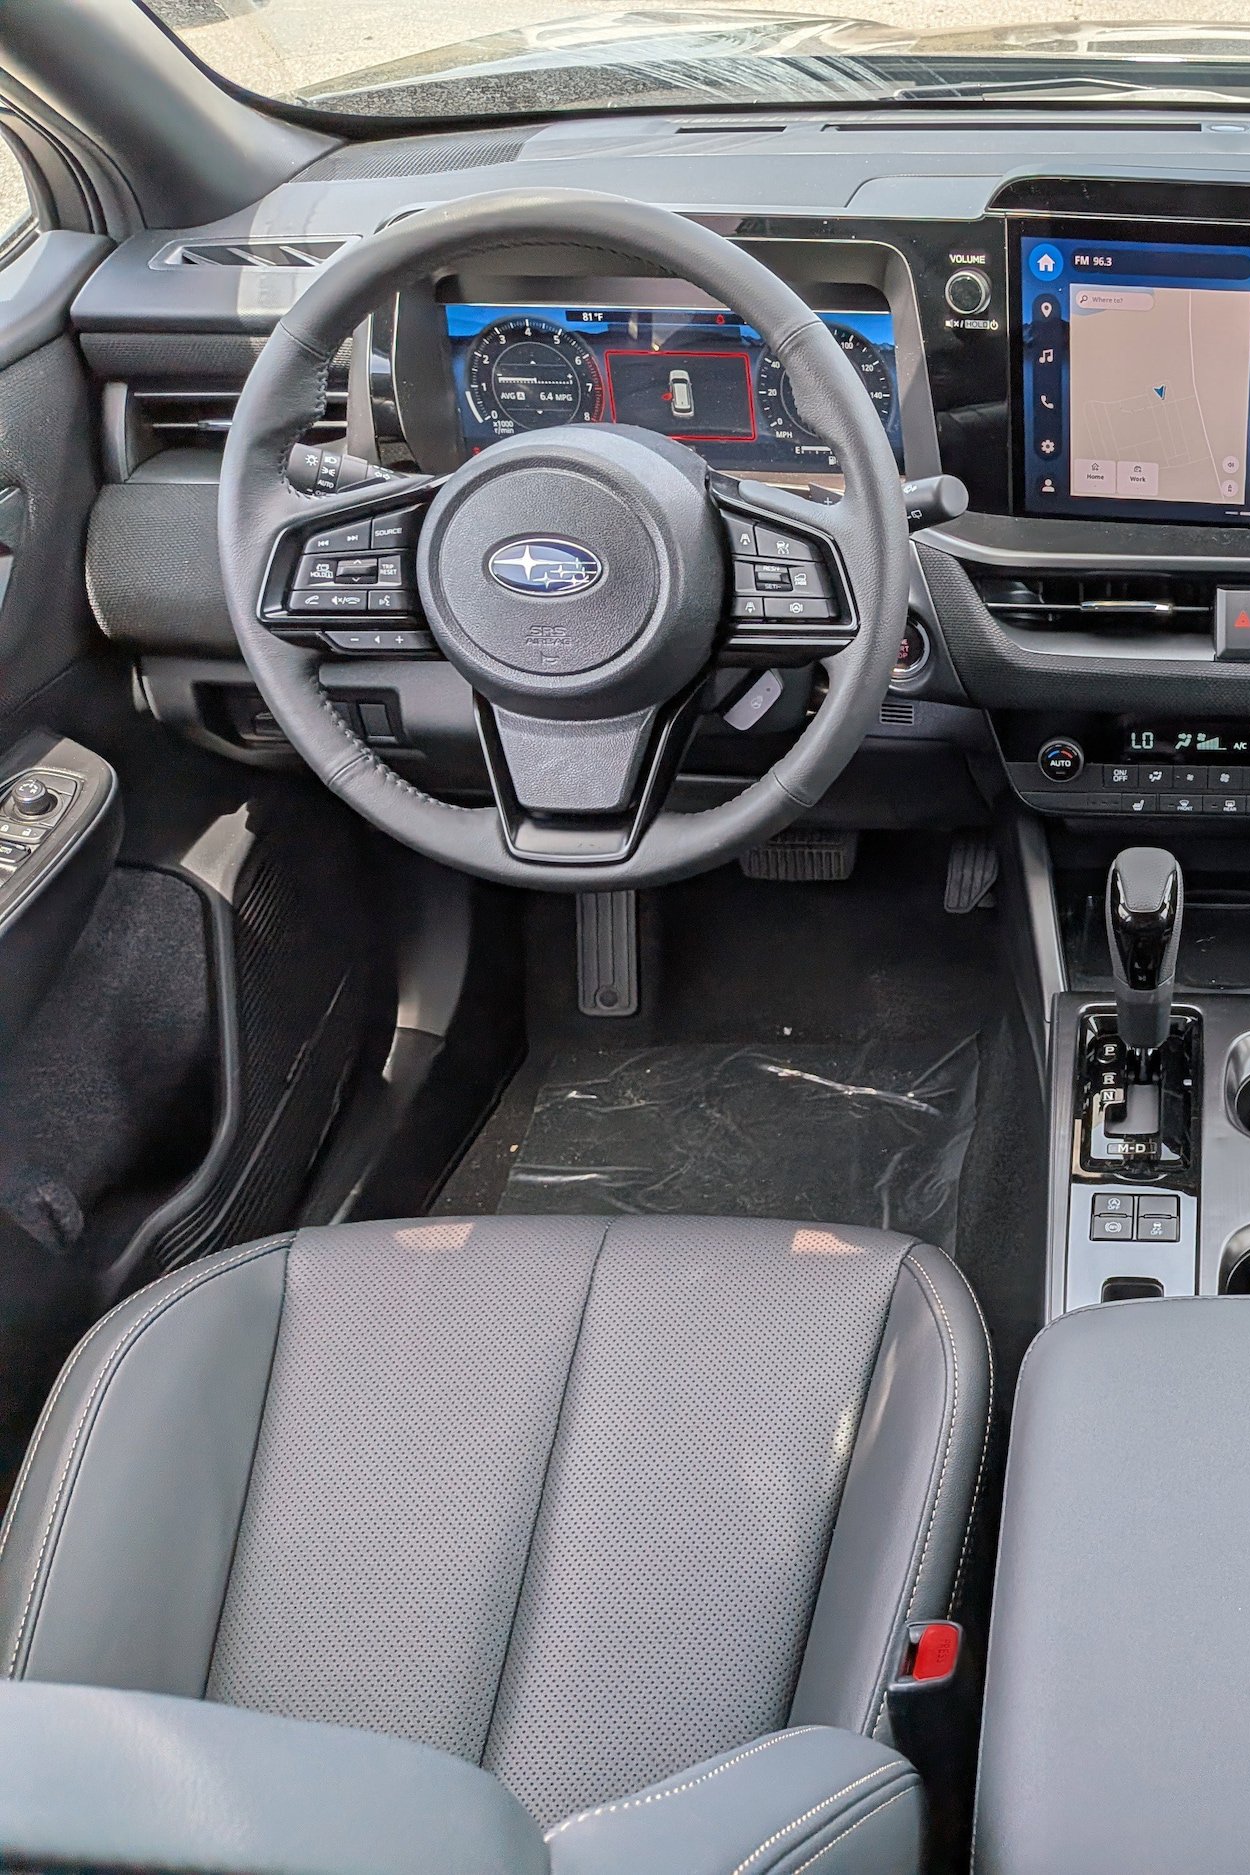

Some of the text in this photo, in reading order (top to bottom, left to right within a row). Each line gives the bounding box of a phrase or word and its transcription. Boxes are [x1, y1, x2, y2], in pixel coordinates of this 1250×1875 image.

[949, 254, 986, 264] VOLUME
[1075, 256, 1113, 267] FM 96.3
[1092, 296, 1123, 304] Where to?
[524, 328, 532, 336] 4
[500, 336, 506, 344] 3
[554, 336, 560, 344] 5
[482, 356, 490, 364] 2
[575, 356, 582, 366] 6
[861, 364, 874, 372] 120
[482, 383, 486, 391] 1
[586, 384, 593, 392] 7
[500, 392, 572, 402] AVG 6.4 MPG
[491, 410, 498, 419] 0
[584, 412, 590, 422] 8
[493, 420, 514, 428] x1000
[1087, 473, 1104, 481] Home
[1130, 476, 1146, 484] Work
[317, 480, 334, 488] AUTO
[375, 528, 402, 536] SOURCE
[530, 626, 566, 636] SRS
[526, 637, 572, 646] AIRBAG
[1130, 732, 1154, 750] LO
[1233, 742, 1248, 750] A/C
[1050, 760, 1071, 768] AUTO
[1104, 1046, 1116, 1056] P
[1103, 1074, 1114, 1084] R
[1103, 1091, 1114, 1100] N
[1118, 1144, 1146, 1153] M-D
